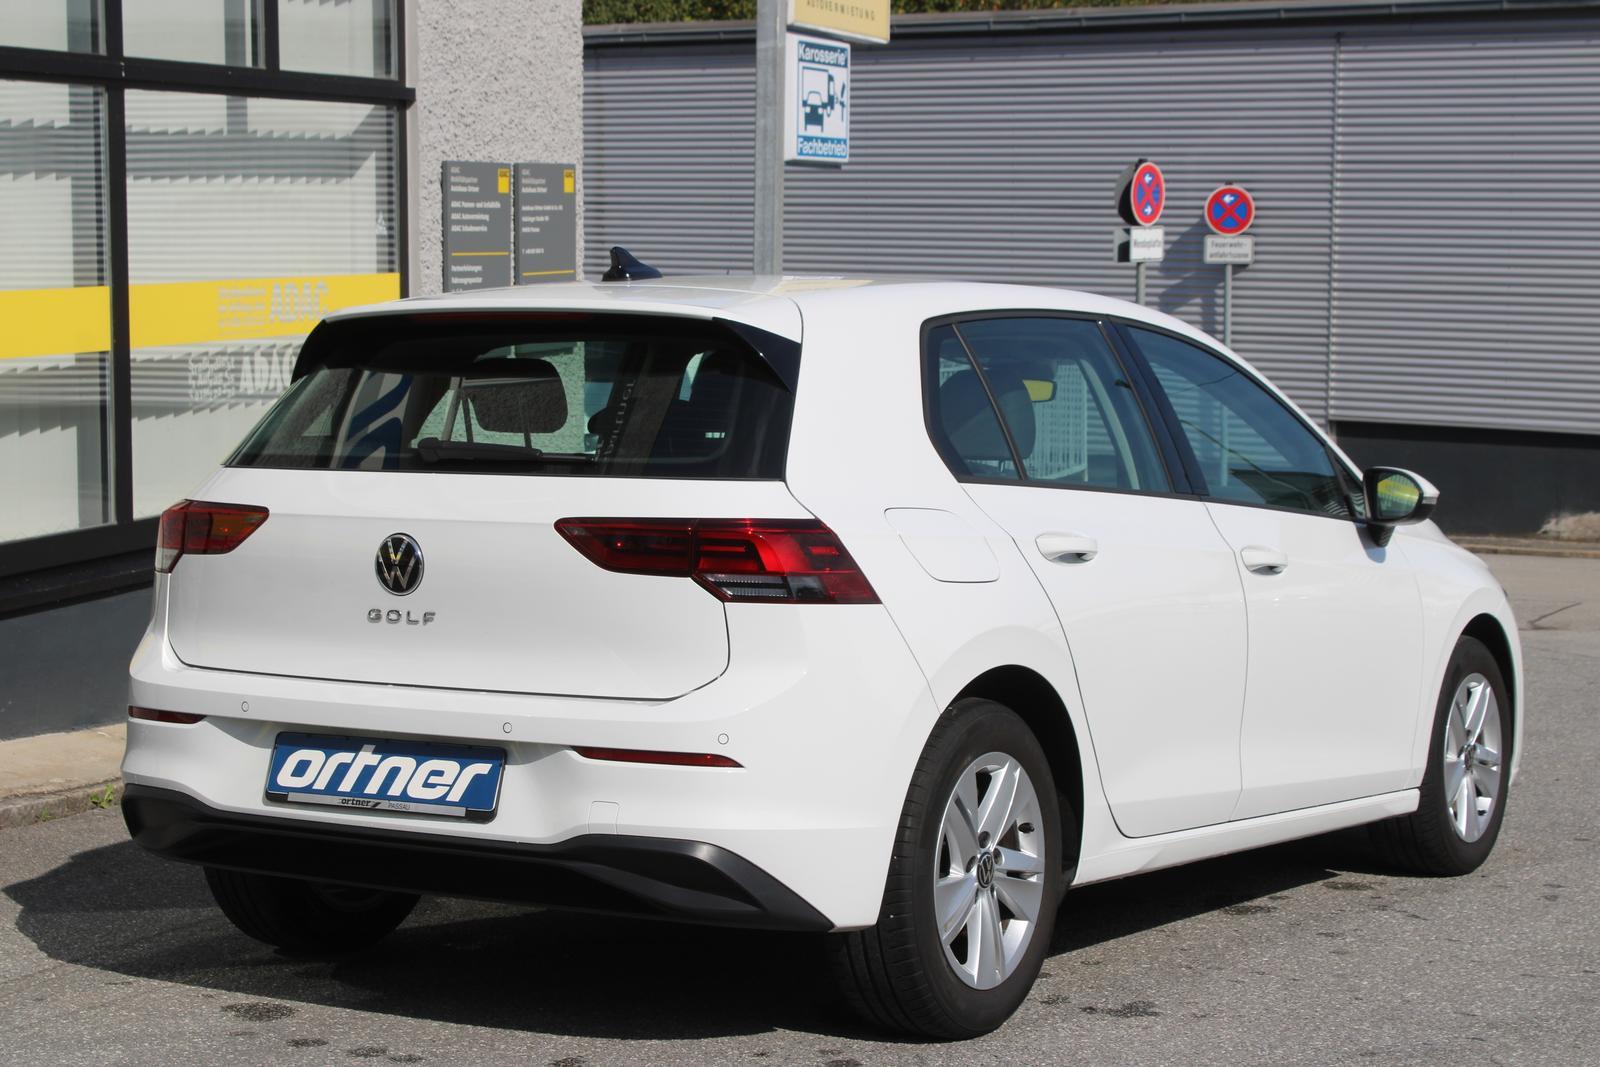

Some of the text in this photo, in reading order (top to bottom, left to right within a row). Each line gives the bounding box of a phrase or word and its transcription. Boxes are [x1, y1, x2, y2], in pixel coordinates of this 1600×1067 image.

[798, 43, 847, 65] Karosserie
[798, 137, 847, 157] Fachbetrieb
[269, 281, 329, 323] ADAC
[367, 607, 436, 626] GOLF
[276, 745, 493, 803] ortner
